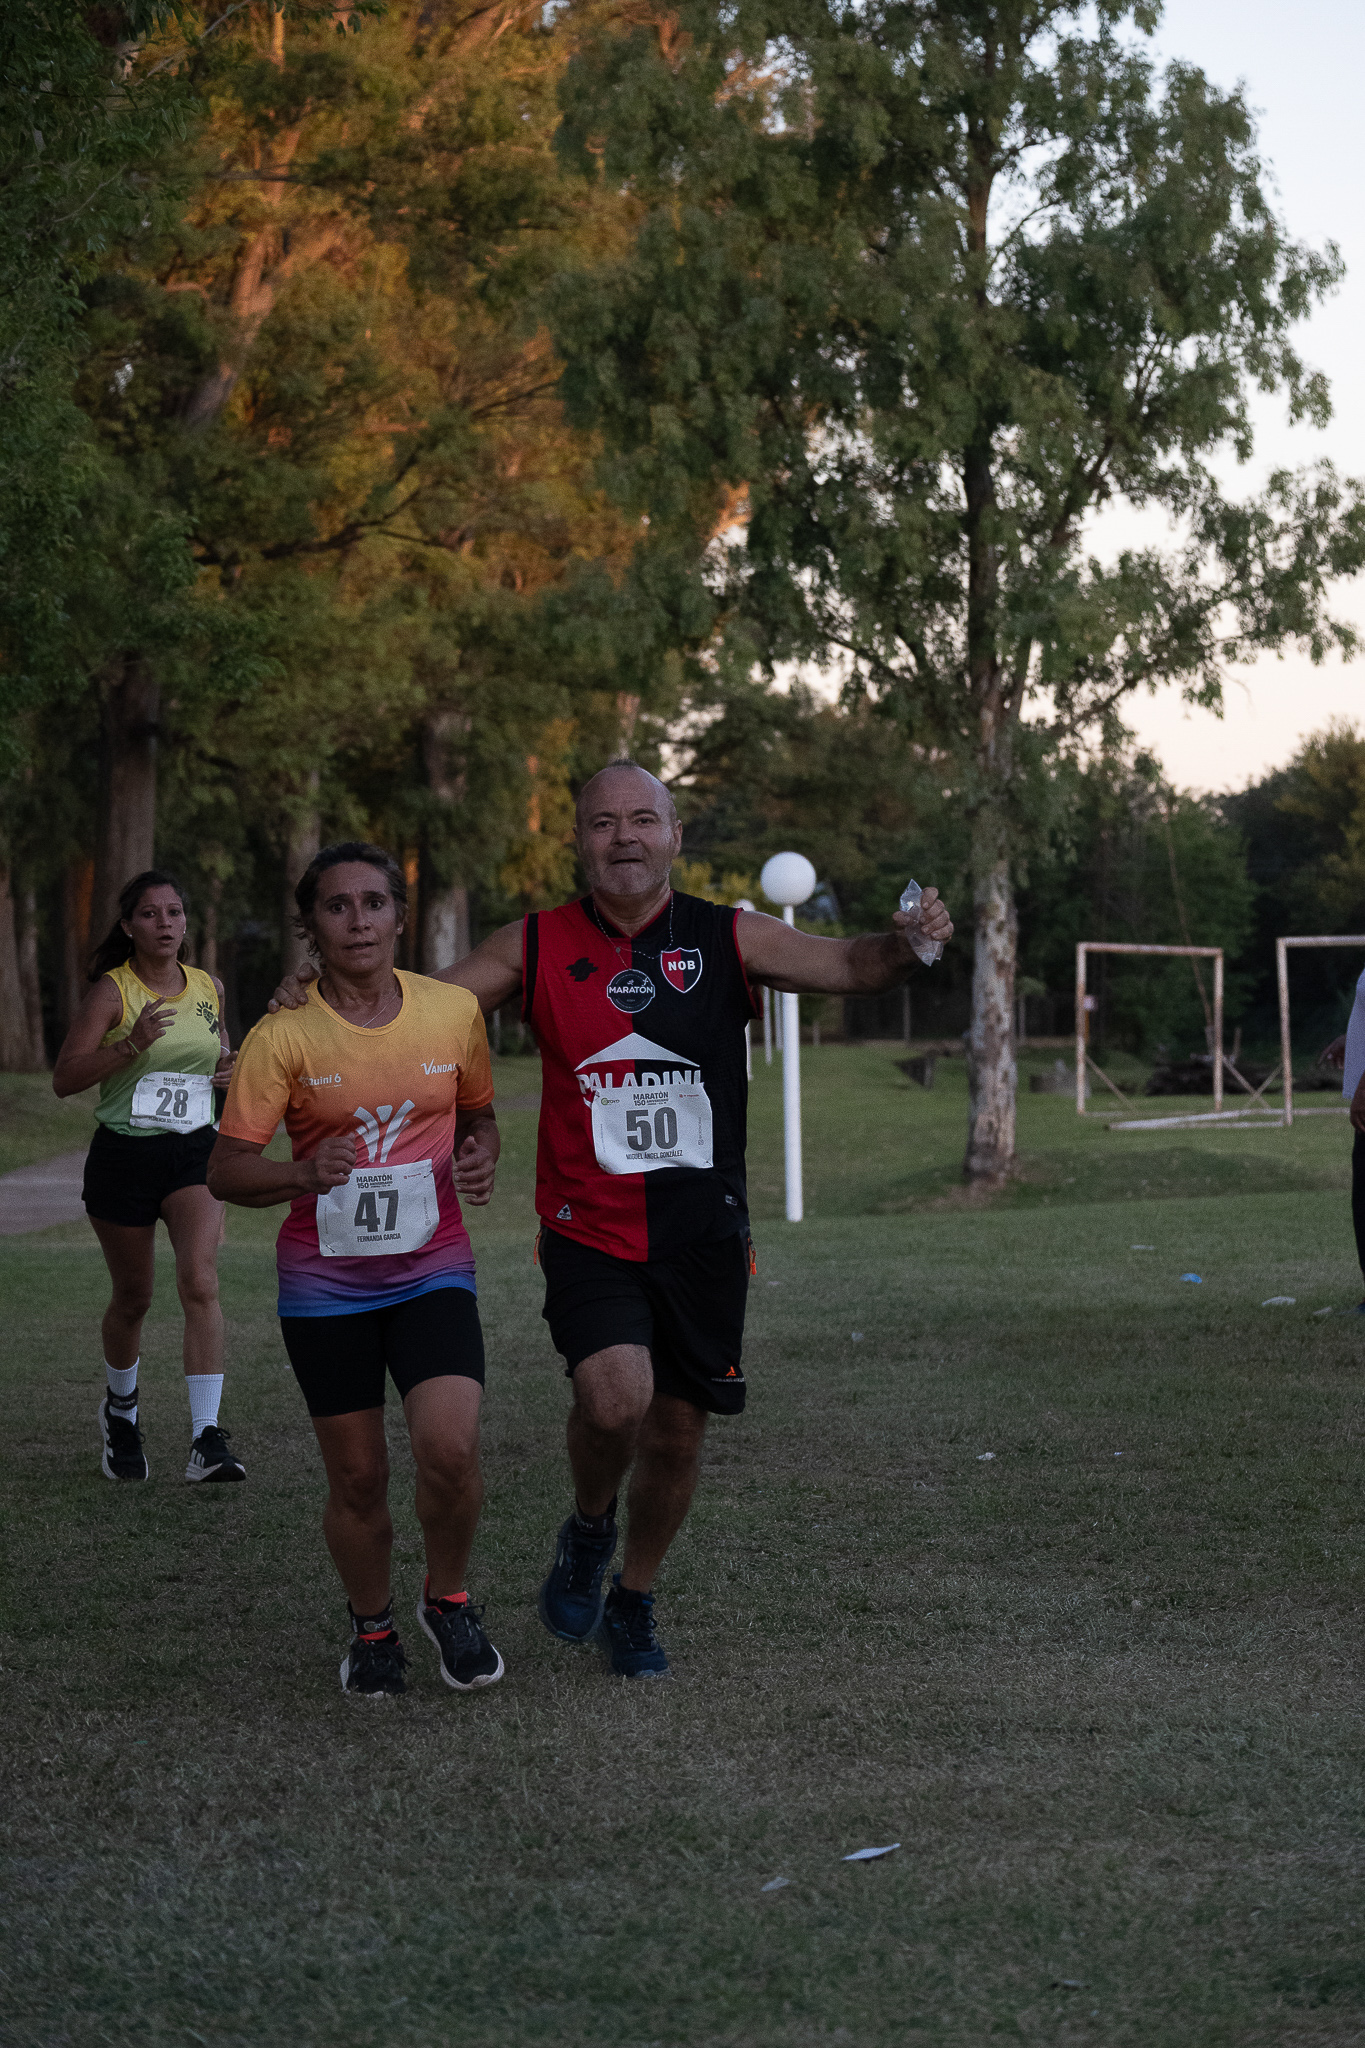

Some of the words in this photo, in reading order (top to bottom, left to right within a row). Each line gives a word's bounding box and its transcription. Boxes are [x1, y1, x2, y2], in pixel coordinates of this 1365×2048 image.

[667, 960, 696, 972] NOB
[334, 1072, 342, 1084] 6
[633, 1091, 669, 1101] MARATÓN
[155, 1087, 189, 1119] 28
[625, 1106, 678, 1152] 50
[356, 1173, 393, 1183] MARATÓN
[354, 1189, 399, 1233] 47
[357, 1234, 383, 1243] FERNANDA
